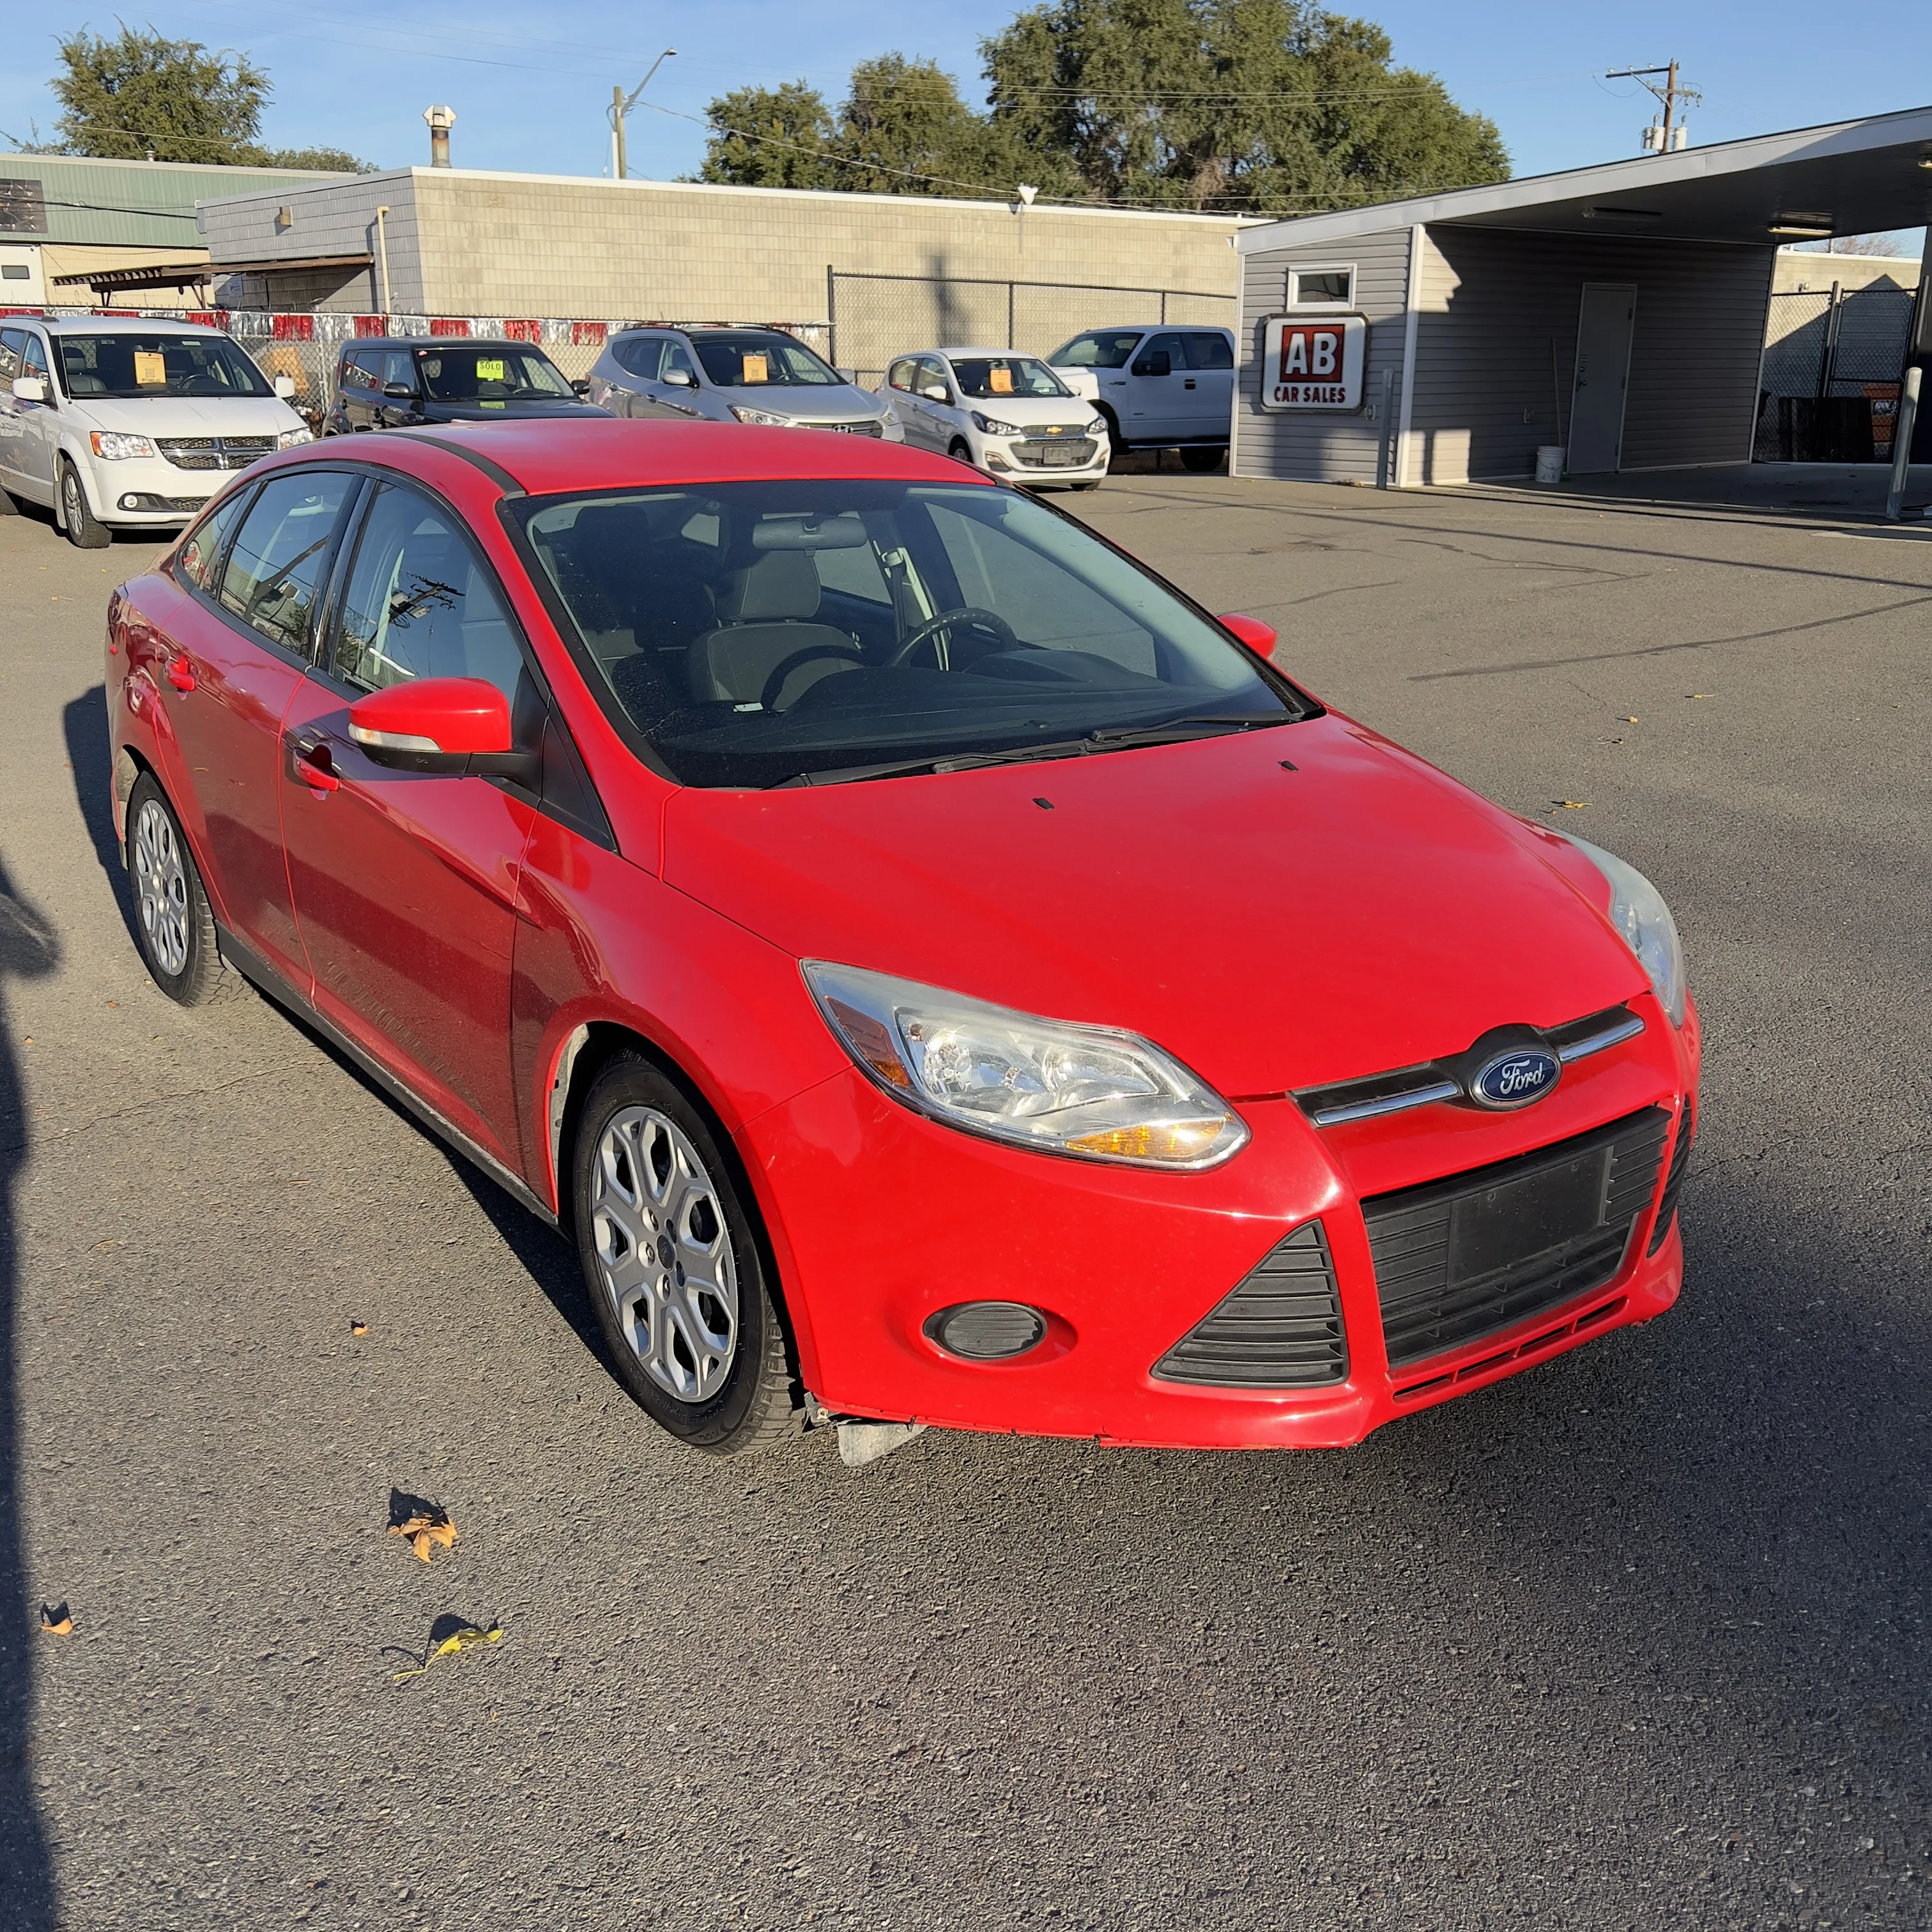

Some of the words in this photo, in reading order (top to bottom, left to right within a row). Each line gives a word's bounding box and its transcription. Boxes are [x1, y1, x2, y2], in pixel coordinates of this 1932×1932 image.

[1284, 331, 1338, 376] AB
[1274, 386, 1299, 402] CAR
[1303, 387, 1346, 403] SALES
[1499, 1059, 1545, 1094] Ford
